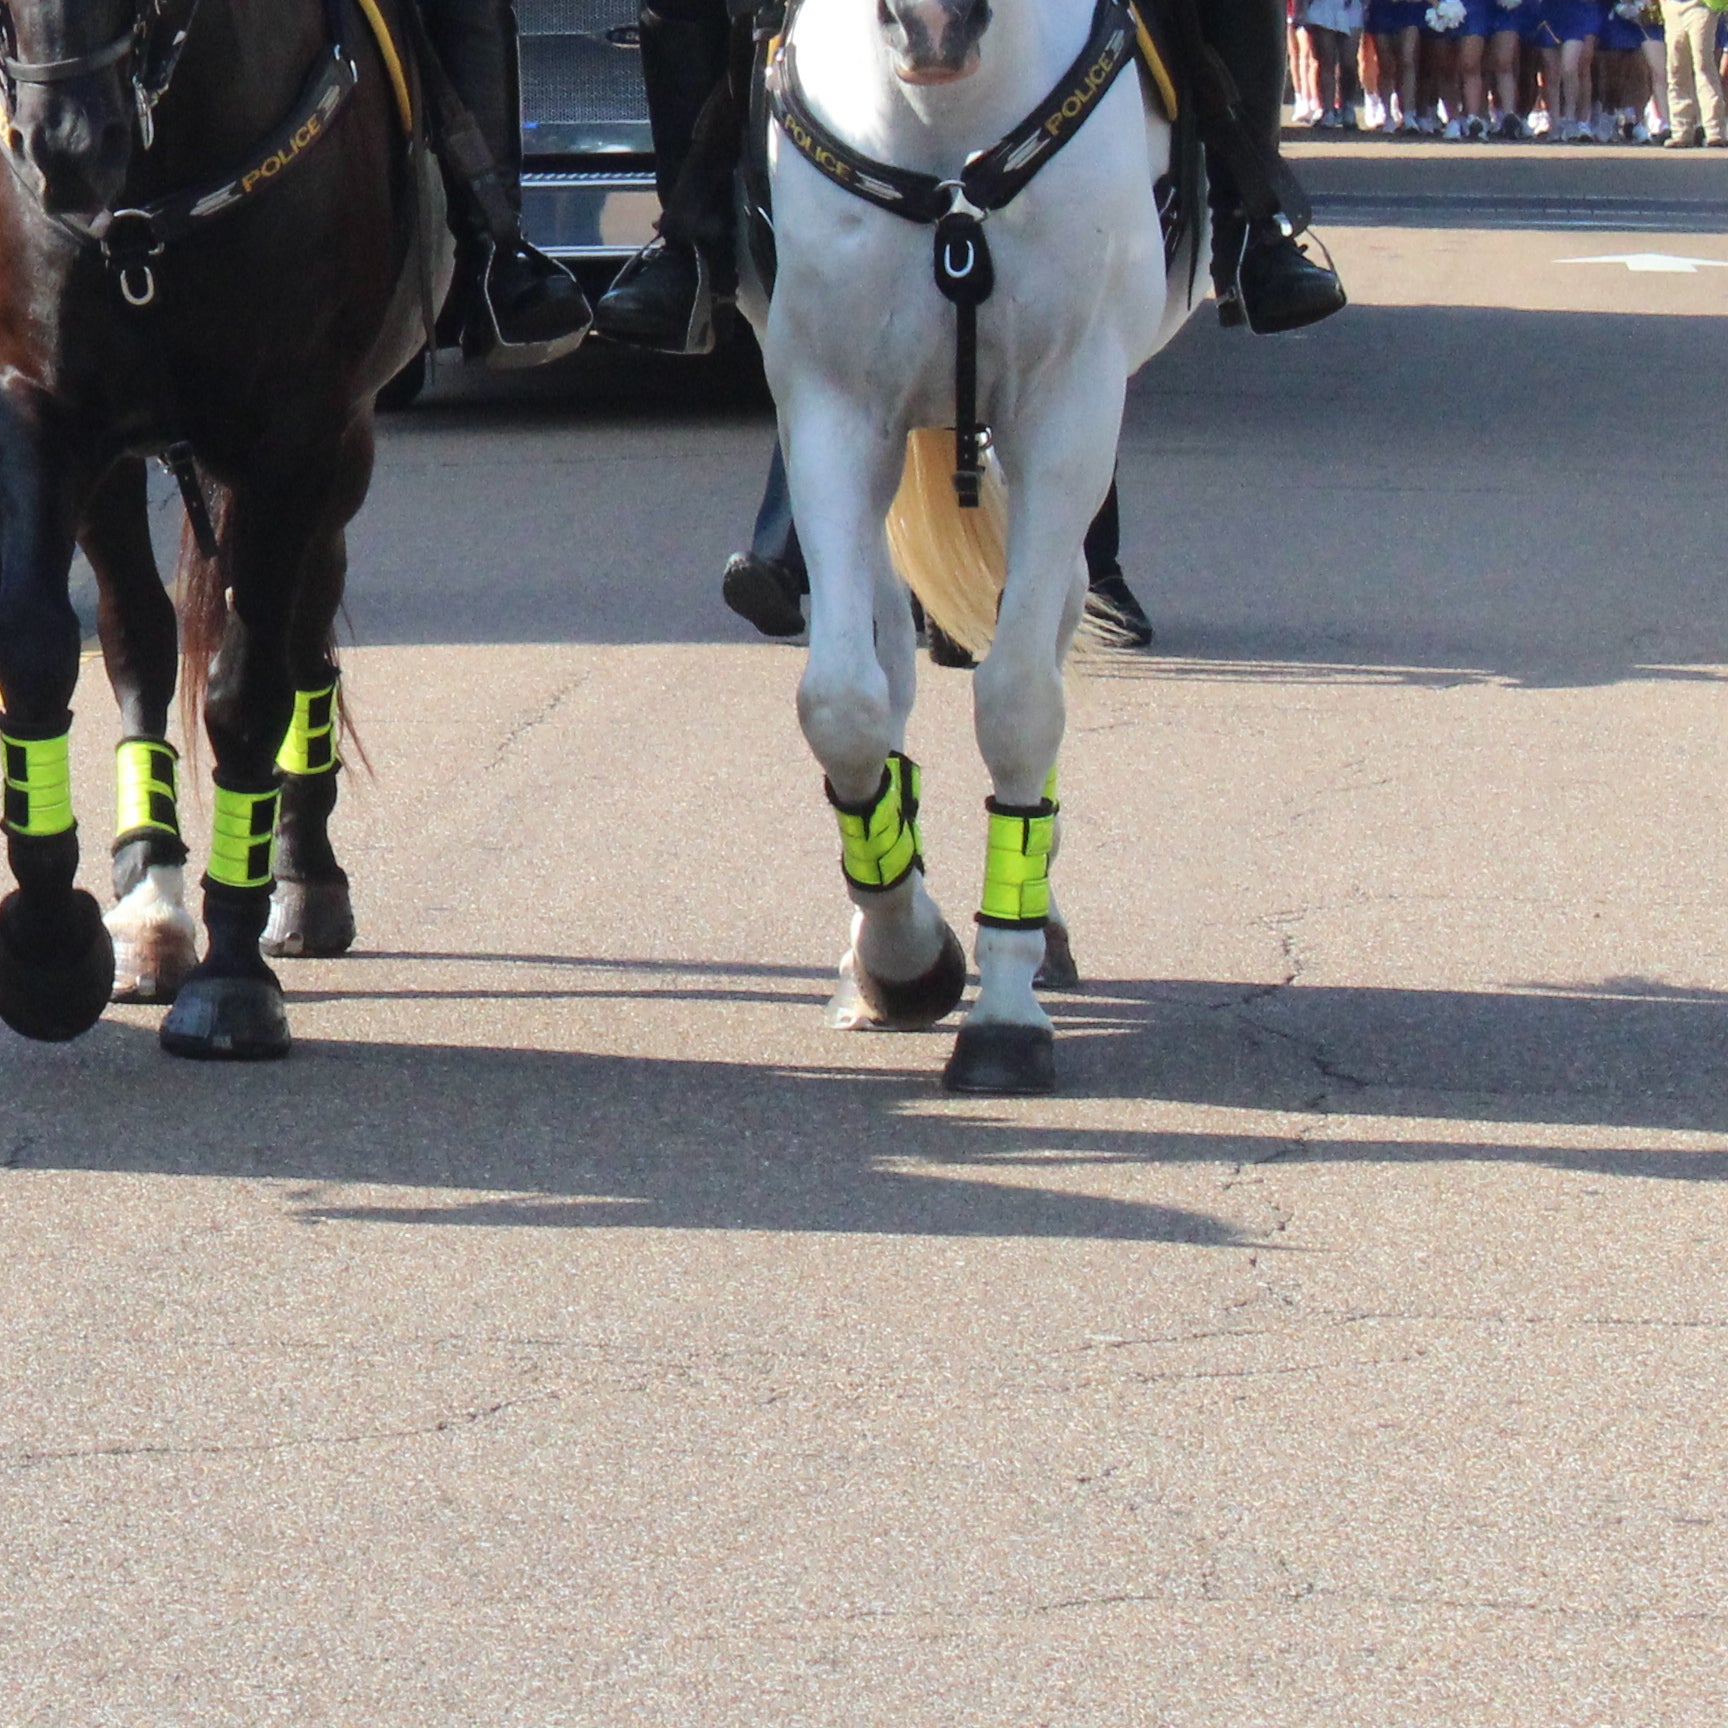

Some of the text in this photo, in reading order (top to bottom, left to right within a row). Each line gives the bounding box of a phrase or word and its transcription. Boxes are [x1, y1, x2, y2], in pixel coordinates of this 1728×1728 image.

[1044, 50, 1115, 137] POLICE
[241, 112, 321, 193] POLICE
[784, 113, 851, 182] POLICE
